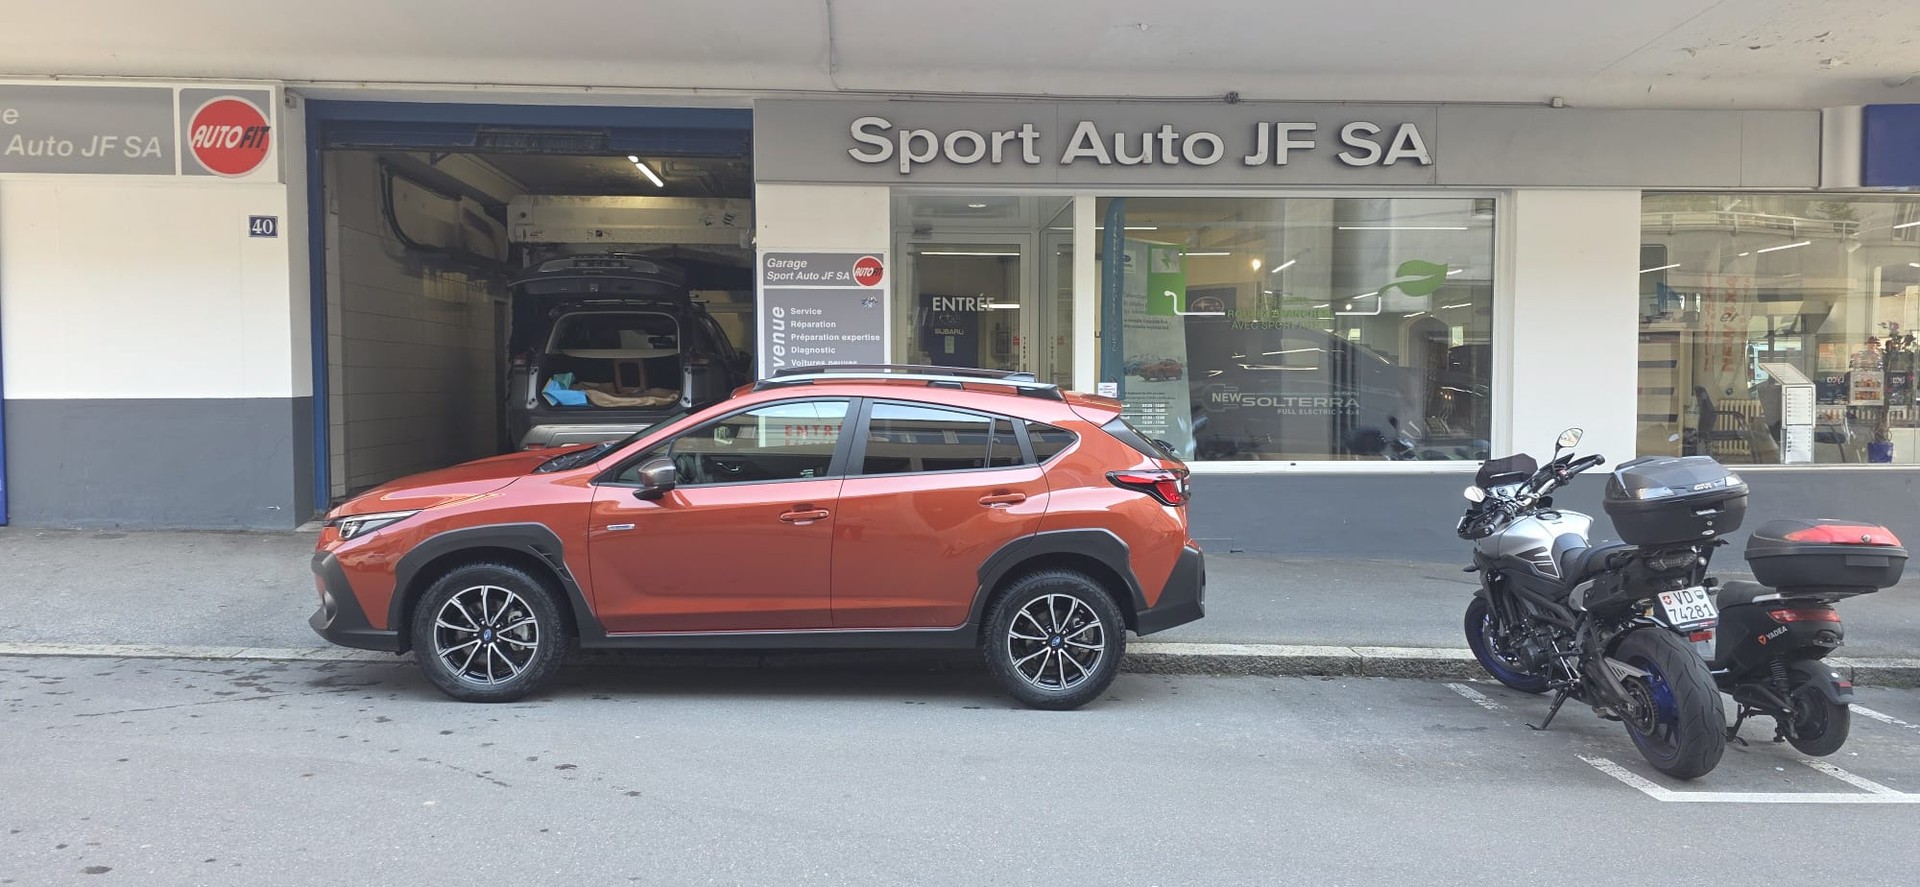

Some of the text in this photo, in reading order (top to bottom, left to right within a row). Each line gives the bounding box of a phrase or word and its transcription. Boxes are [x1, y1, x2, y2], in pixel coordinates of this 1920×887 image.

[193, 124, 271, 149] AUTOFIT
[4, 134, 162, 158] Auto JF SA
[847, 116, 1434, 174] Sport Auto JF SA
[251, 219, 273, 235] 40
[767, 258, 808, 270] Garage
[766, 271, 850, 281] Sport Auto JF SA
[932, 293, 995, 312] ENTRÉE
[790, 307, 822, 315] Service
[790, 320, 836, 329] Réparation
[772, 306, 785, 374] venue
[790, 333, 880, 342] Préparation expertise
[791, 346, 836, 355] Diagnostic
[791, 359, 826, 367] Voitures
[1212, 392, 1360, 408] NEW SOLTERRA
[1672, 590, 1694, 605] VD
[1668, 603, 1714, 623] 74281
[1766, 625, 1788, 641] YADEA
